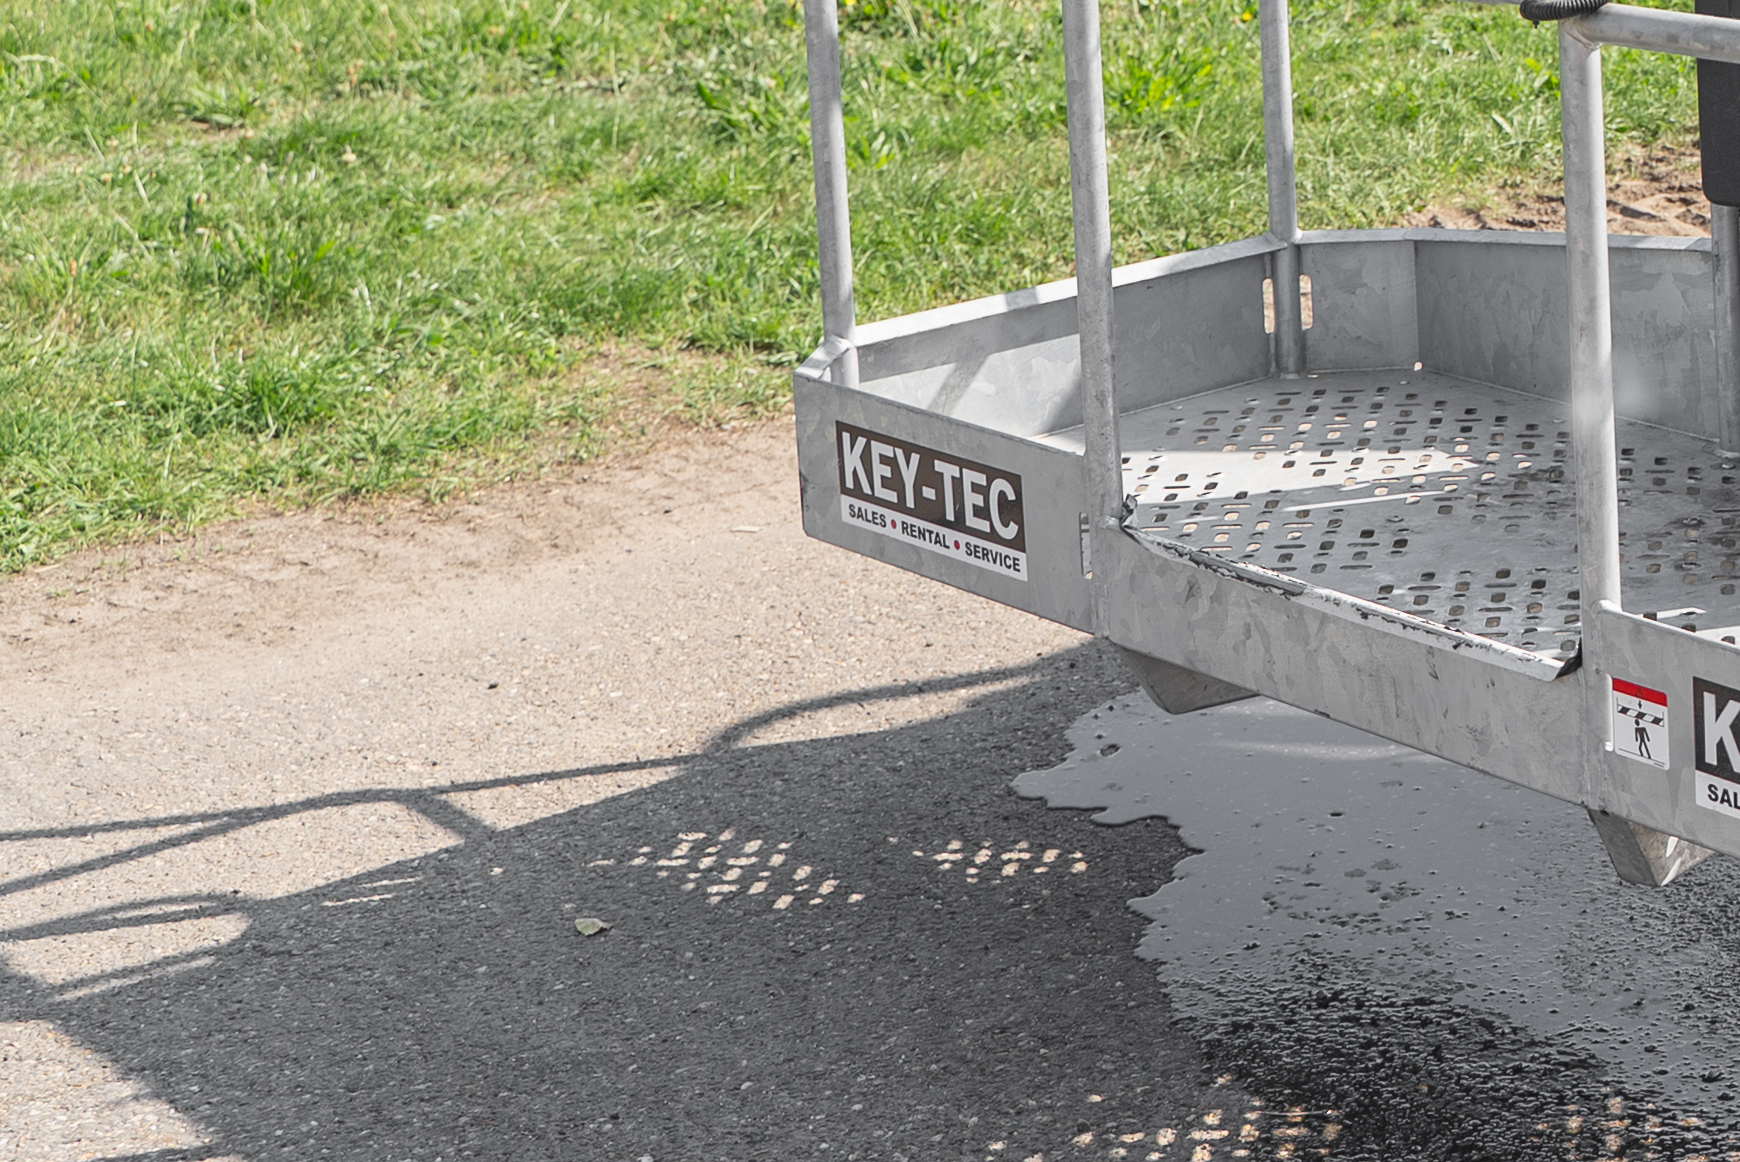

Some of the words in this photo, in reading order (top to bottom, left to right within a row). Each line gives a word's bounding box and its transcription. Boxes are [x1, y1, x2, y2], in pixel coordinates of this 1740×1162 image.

[841, 430, 1019, 540] KEY-TEC
[848, 503, 888, 529] SALES
[900, 520, 951, 550] RENTAL
[964, 541, 1021, 573] SERVICE
